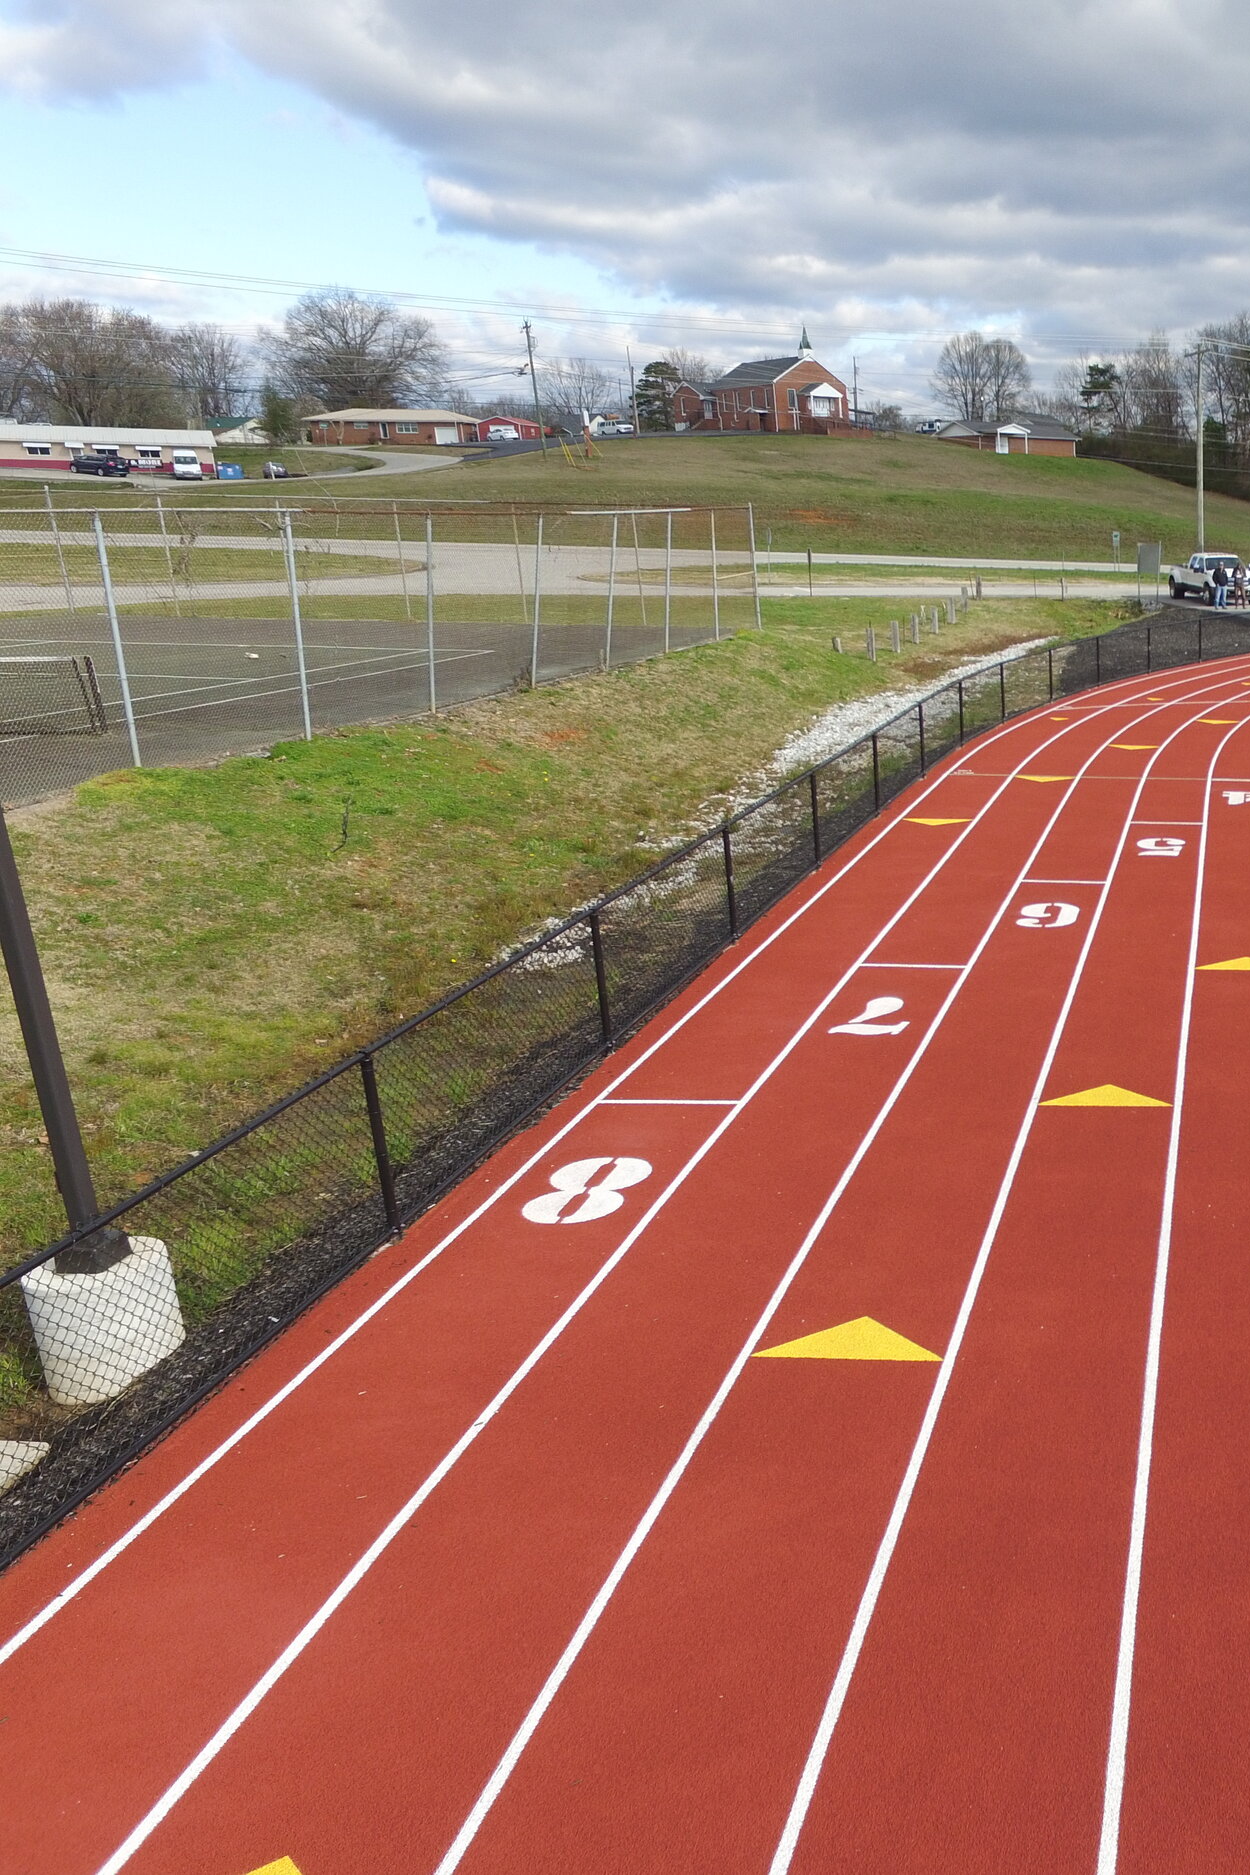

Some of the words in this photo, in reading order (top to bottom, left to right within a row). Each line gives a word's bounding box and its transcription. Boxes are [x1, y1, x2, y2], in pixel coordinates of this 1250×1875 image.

[1136, 837, 1186, 857] 5
[1016, 903, 1080, 927] 6
[828, 996, 910, 1035] 7
[521, 1157, 652, 1224] 8
